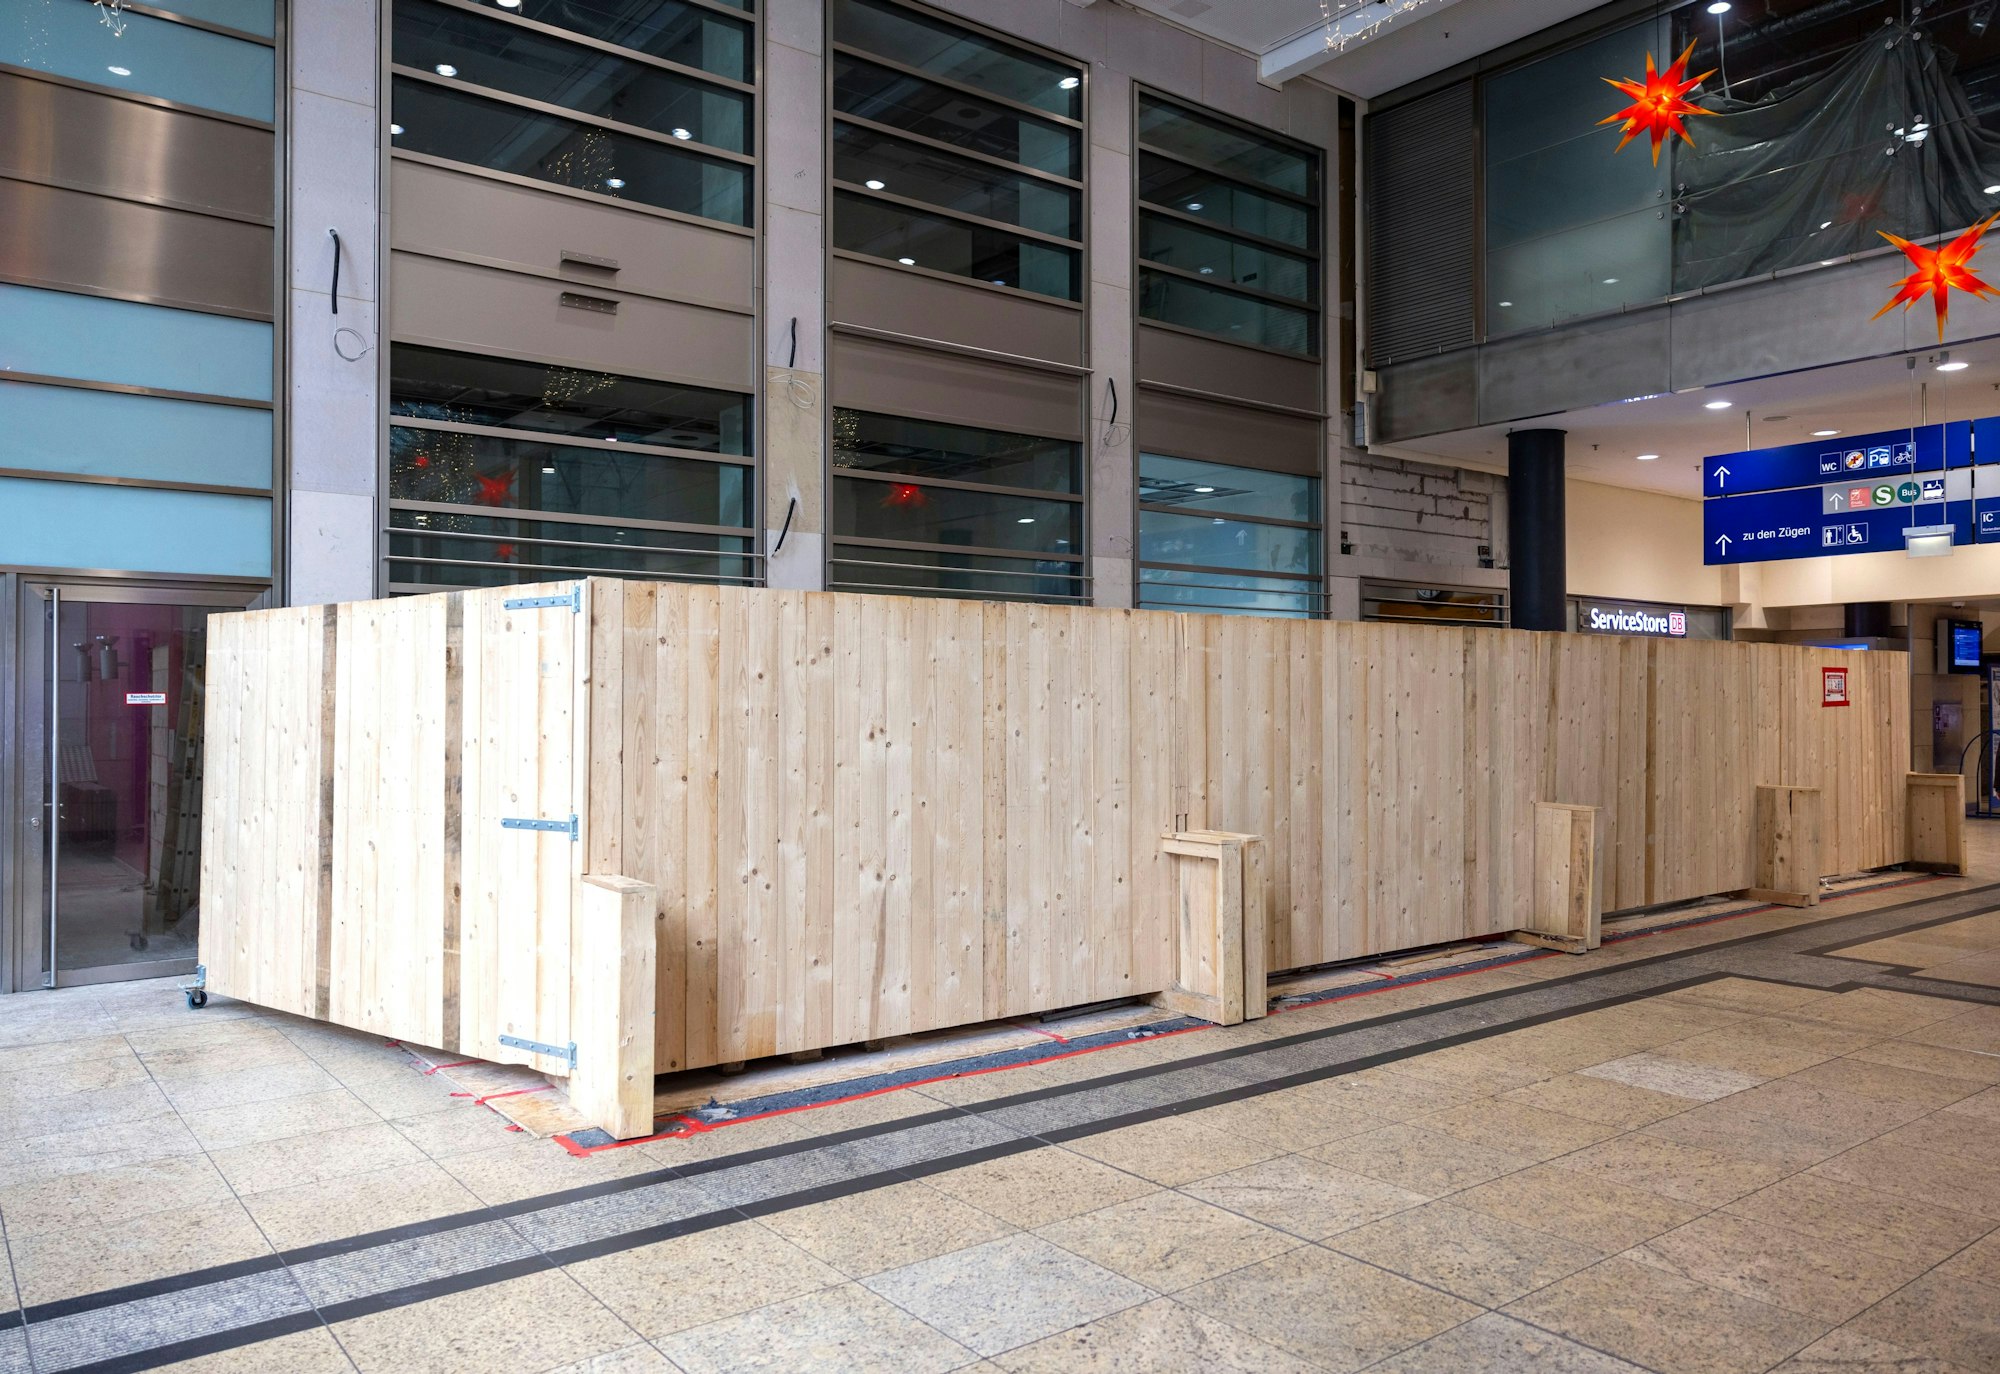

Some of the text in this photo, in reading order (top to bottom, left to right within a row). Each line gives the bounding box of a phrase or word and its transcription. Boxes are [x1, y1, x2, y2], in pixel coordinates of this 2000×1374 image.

[1821, 462, 1837, 471] WC
[1869, 454, 1879, 467] P
[1876, 486, 1891, 504] S
[1901, 489, 1917, 497] Bus
[1982, 513, 1993, 522] IC
[1743, 527, 1810, 540] zu den Zügen
[1590, 608, 1668, 633] ServiceStore
